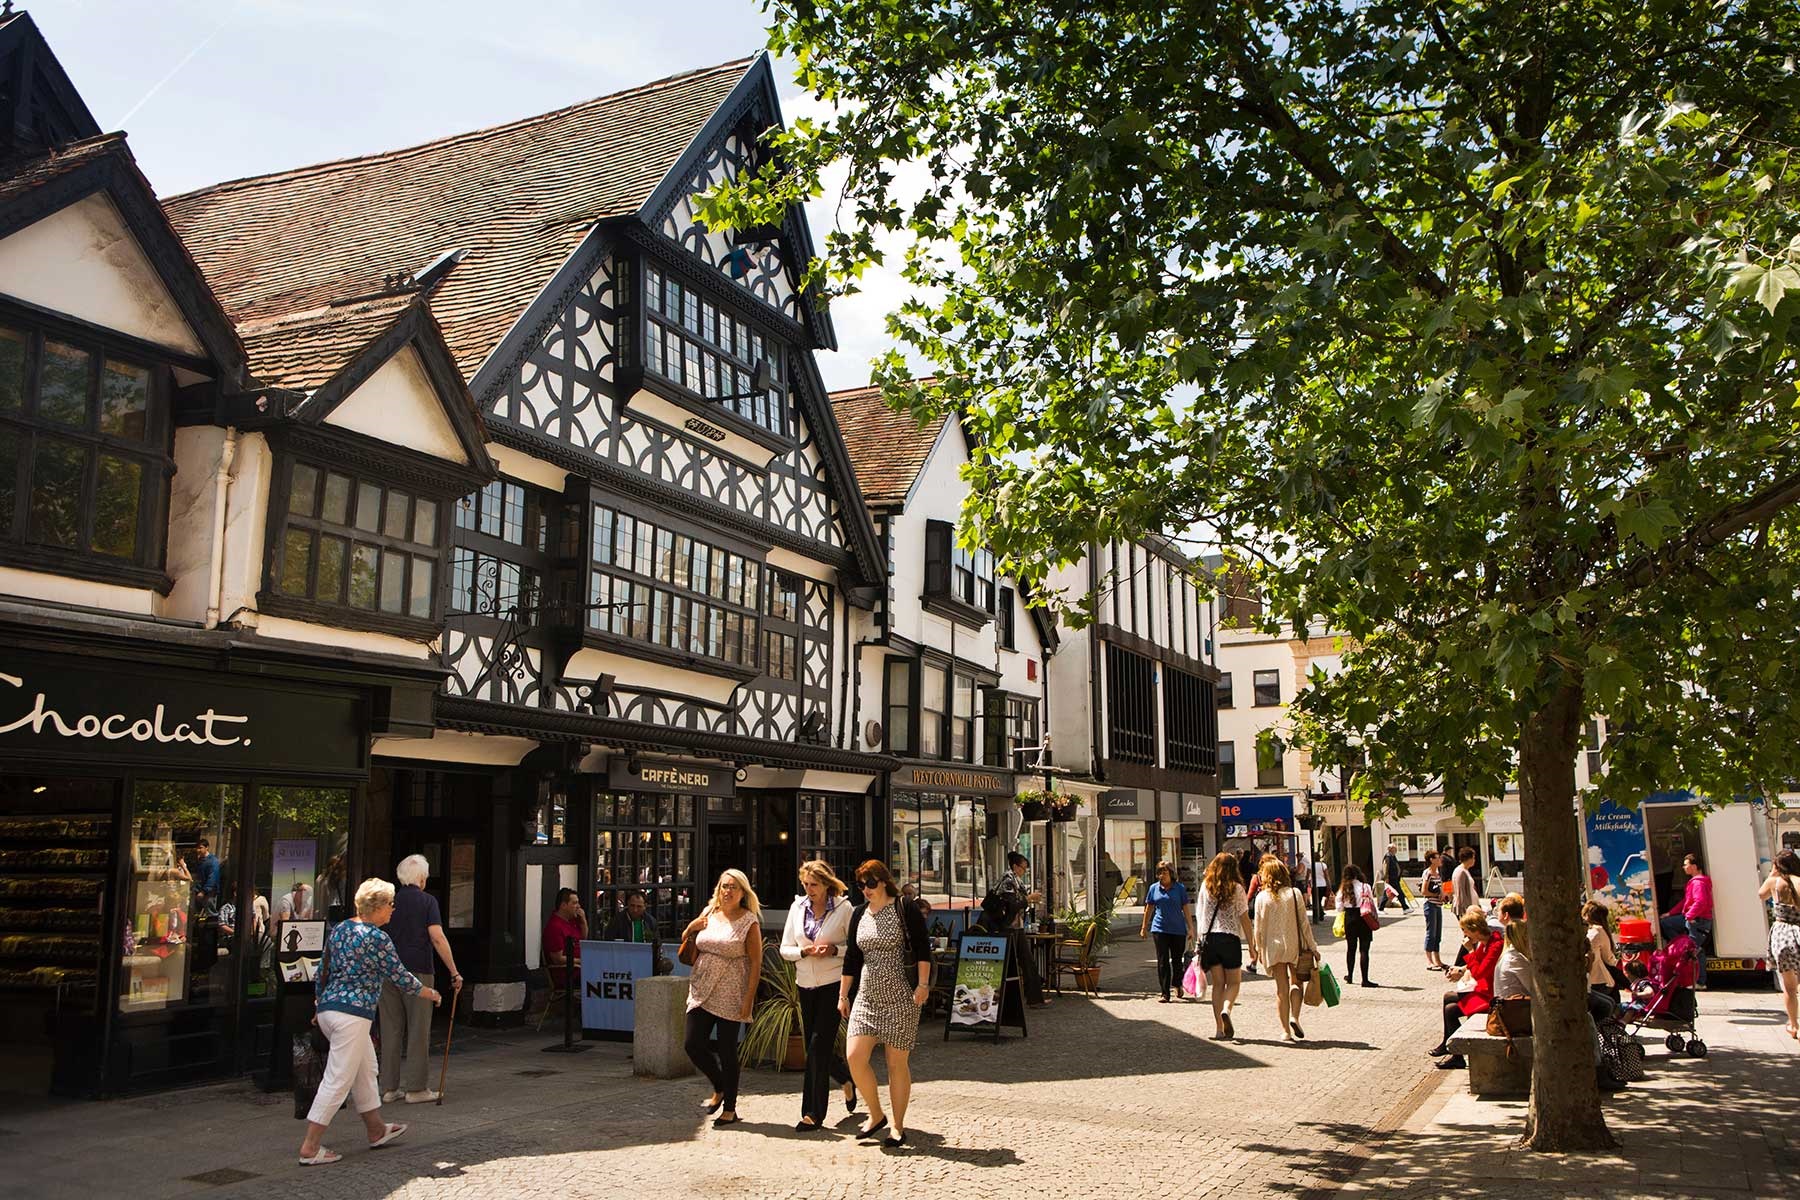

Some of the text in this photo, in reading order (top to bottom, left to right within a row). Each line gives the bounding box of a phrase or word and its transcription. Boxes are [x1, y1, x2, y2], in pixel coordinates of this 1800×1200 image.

[641, 767, 709, 786] CAFFÈ NERO
[912, 769, 934, 785] WEST
[934, 770, 973, 787] CORNWALL
[973, 773, 992, 789] PASTY
[1107, 798, 1135, 807] Clarks
[1316, 804, 1363, 813] Bath Pace
[1595, 812, 1632, 821] Ice Cream
[967, 945, 1000, 954] NERO
[1723, 960, 1741, 970] FFL
